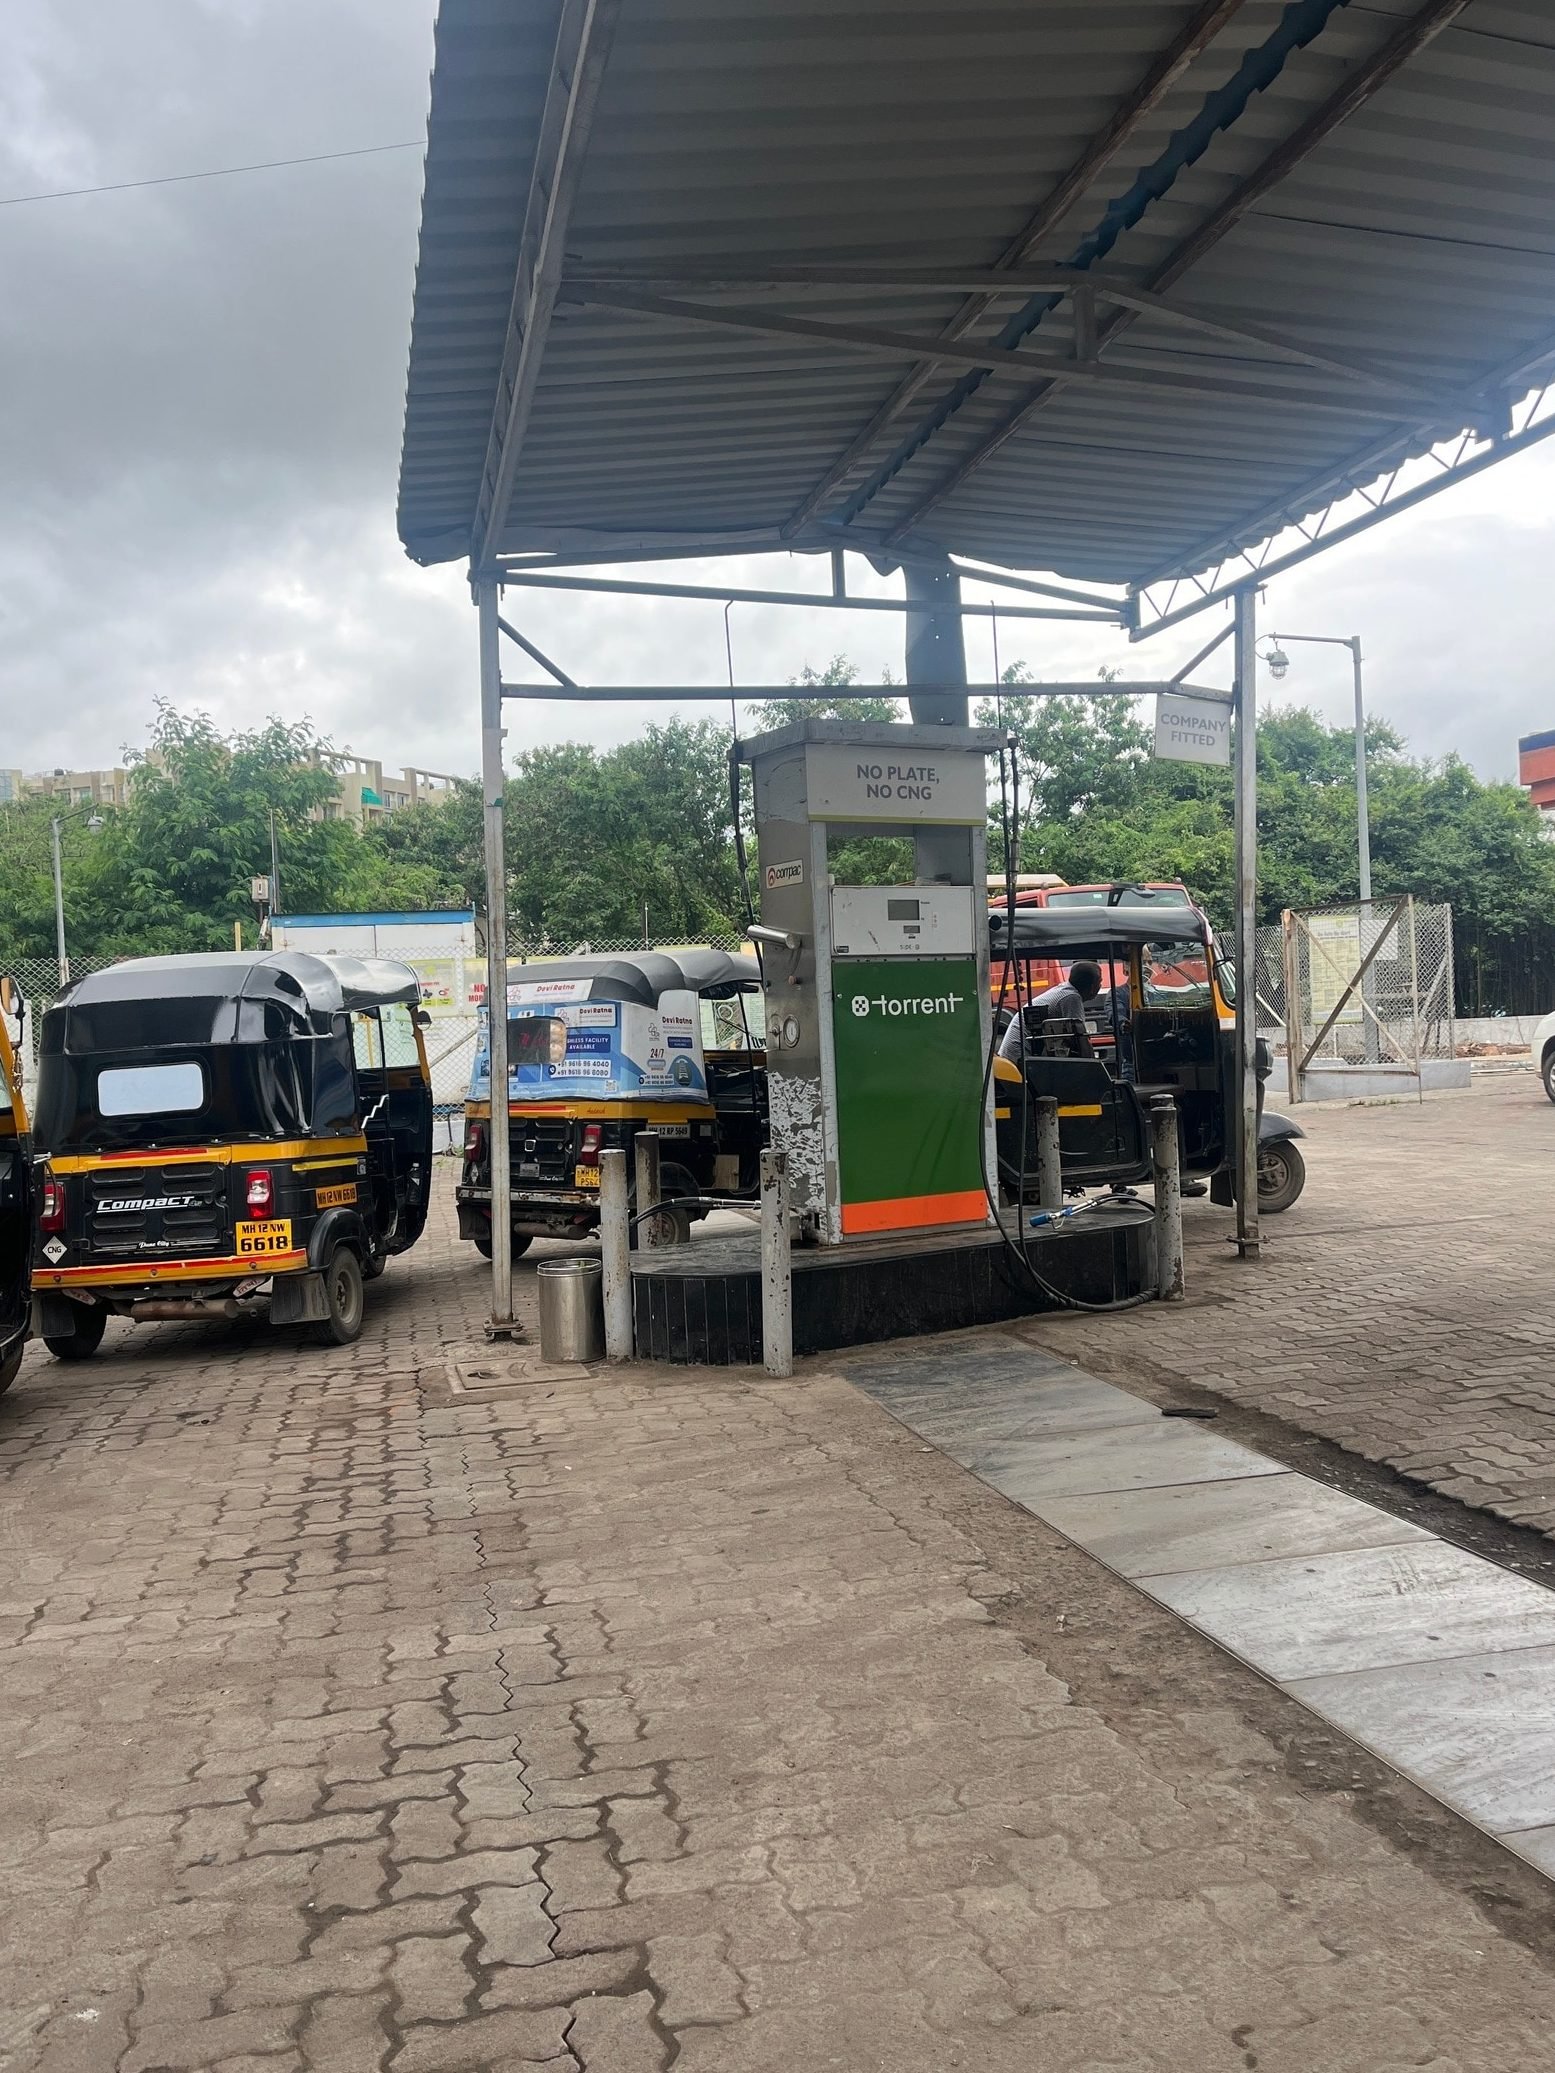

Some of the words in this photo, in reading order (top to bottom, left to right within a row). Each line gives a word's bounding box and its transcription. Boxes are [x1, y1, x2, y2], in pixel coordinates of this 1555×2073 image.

[1161, 713, 1226, 732] COMPANY
[1171, 731, 1215, 746] FITTED
[857, 764, 882, 779] NO
[887, 766, 939, 784] PLATE,
[866, 784, 892, 798] NO
[897, 785, 932, 800] CNG
[776, 865, 801, 879] compac
[872, 993, 963, 1015] torrent
[650, 1048, 664, 1058] 24/7
[317, 1192, 326, 1204] MH
[327, 1191, 333, 1203] 12
[333, 1190, 342, 1202] NW
[342, 1188, 356, 1200] 6618
[242, 1224, 256, 1234] MH
[258, 1224, 268, 1233] 12
[270, 1223, 286, 1233] NW
[48, 1246, 62, 1254] CNG
[240, 1236, 288, 1251] 6618
